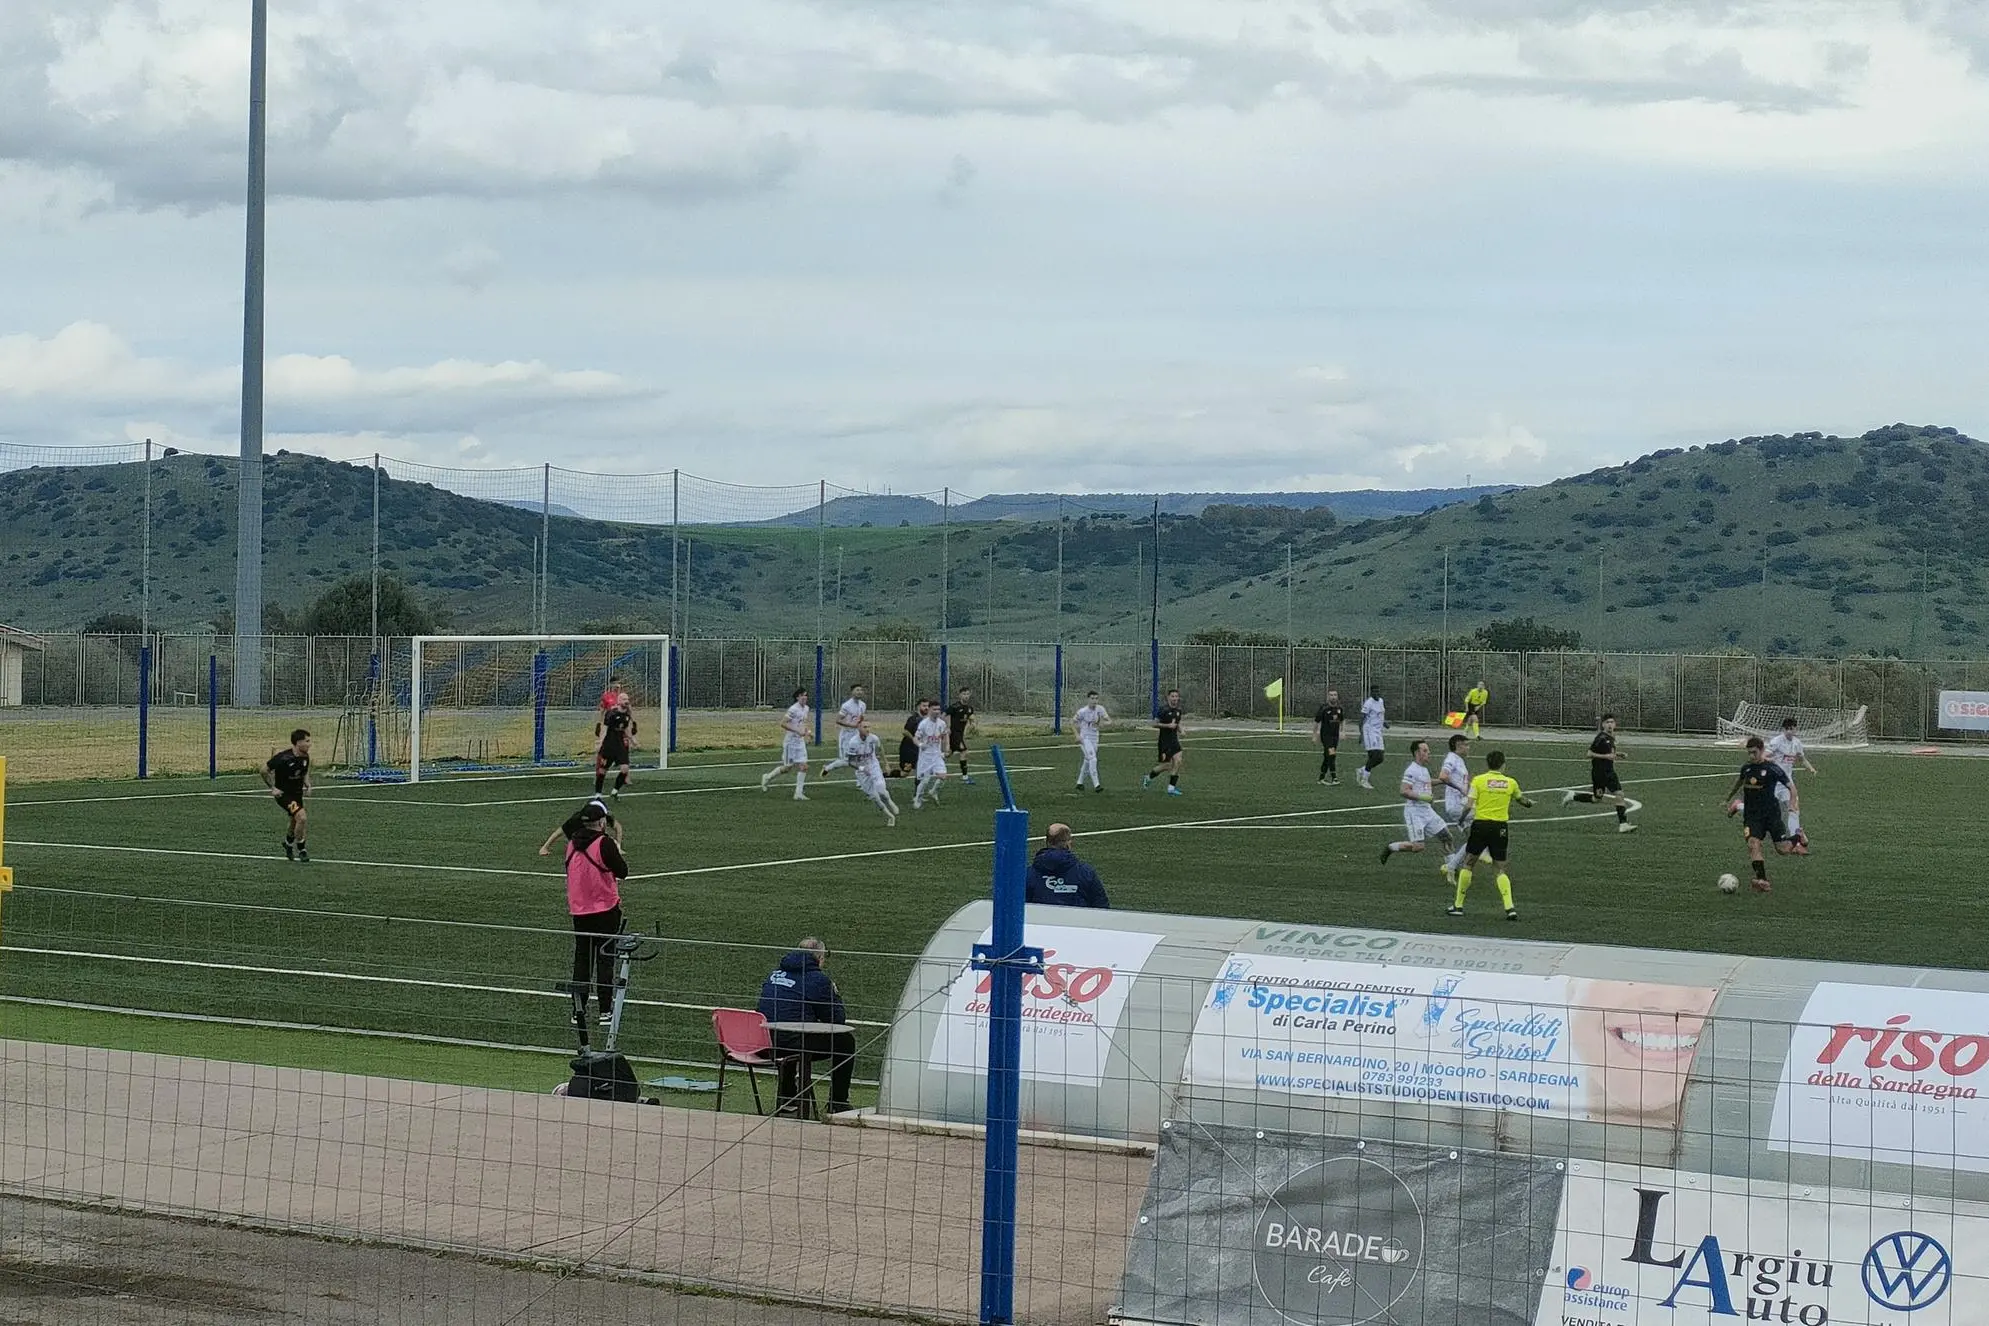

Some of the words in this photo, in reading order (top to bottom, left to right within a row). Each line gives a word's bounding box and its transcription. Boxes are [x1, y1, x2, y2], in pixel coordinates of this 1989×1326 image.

[1256, 927, 1398, 950] VINCO
[1355, 951, 1393, 962] TEL.
[1248, 975, 1299, 986] CENTRO
[1303, 979, 1350, 990] MEDICI
[1353, 983, 1416, 994] DENTISTI
[965, 999, 992, 1014] del
[1022, 1005, 1094, 1025] ardegna
[1272, 1014, 1288, 1027] di
[1293, 1015, 1337, 1031] Carla
[1342, 1020, 1397, 1036] Perino
[1816, 1014, 1989, 1077] riso
[1241, 1048, 1263, 1060] VIA
[1265, 1050, 1295, 1063] SAN
[1297, 1052, 1391, 1073] BERNARDINO,
[1394, 1061, 1411, 1073] 20
[1499, 1069, 1580, 1089] SARDEGNA
[1362, 1070, 1394, 1083] 0783
[1256, 1073, 1550, 1110] WWW.SPECIALISTSTUDIODENTISTICO.COM
[1807, 1070, 1863, 1090] della
[1869, 1075, 1978, 1100] Sardegna
[1828, 1095, 1852, 1106] Alta
[1855, 1098, 1898, 1111] Qualità
[1900, 1102, 1919, 1112] dal
[1922, 1104, 1947, 1115] 1951
[1564, 1291, 1629, 1311] assistance
[1592, 1283, 1631, 1300] europ
